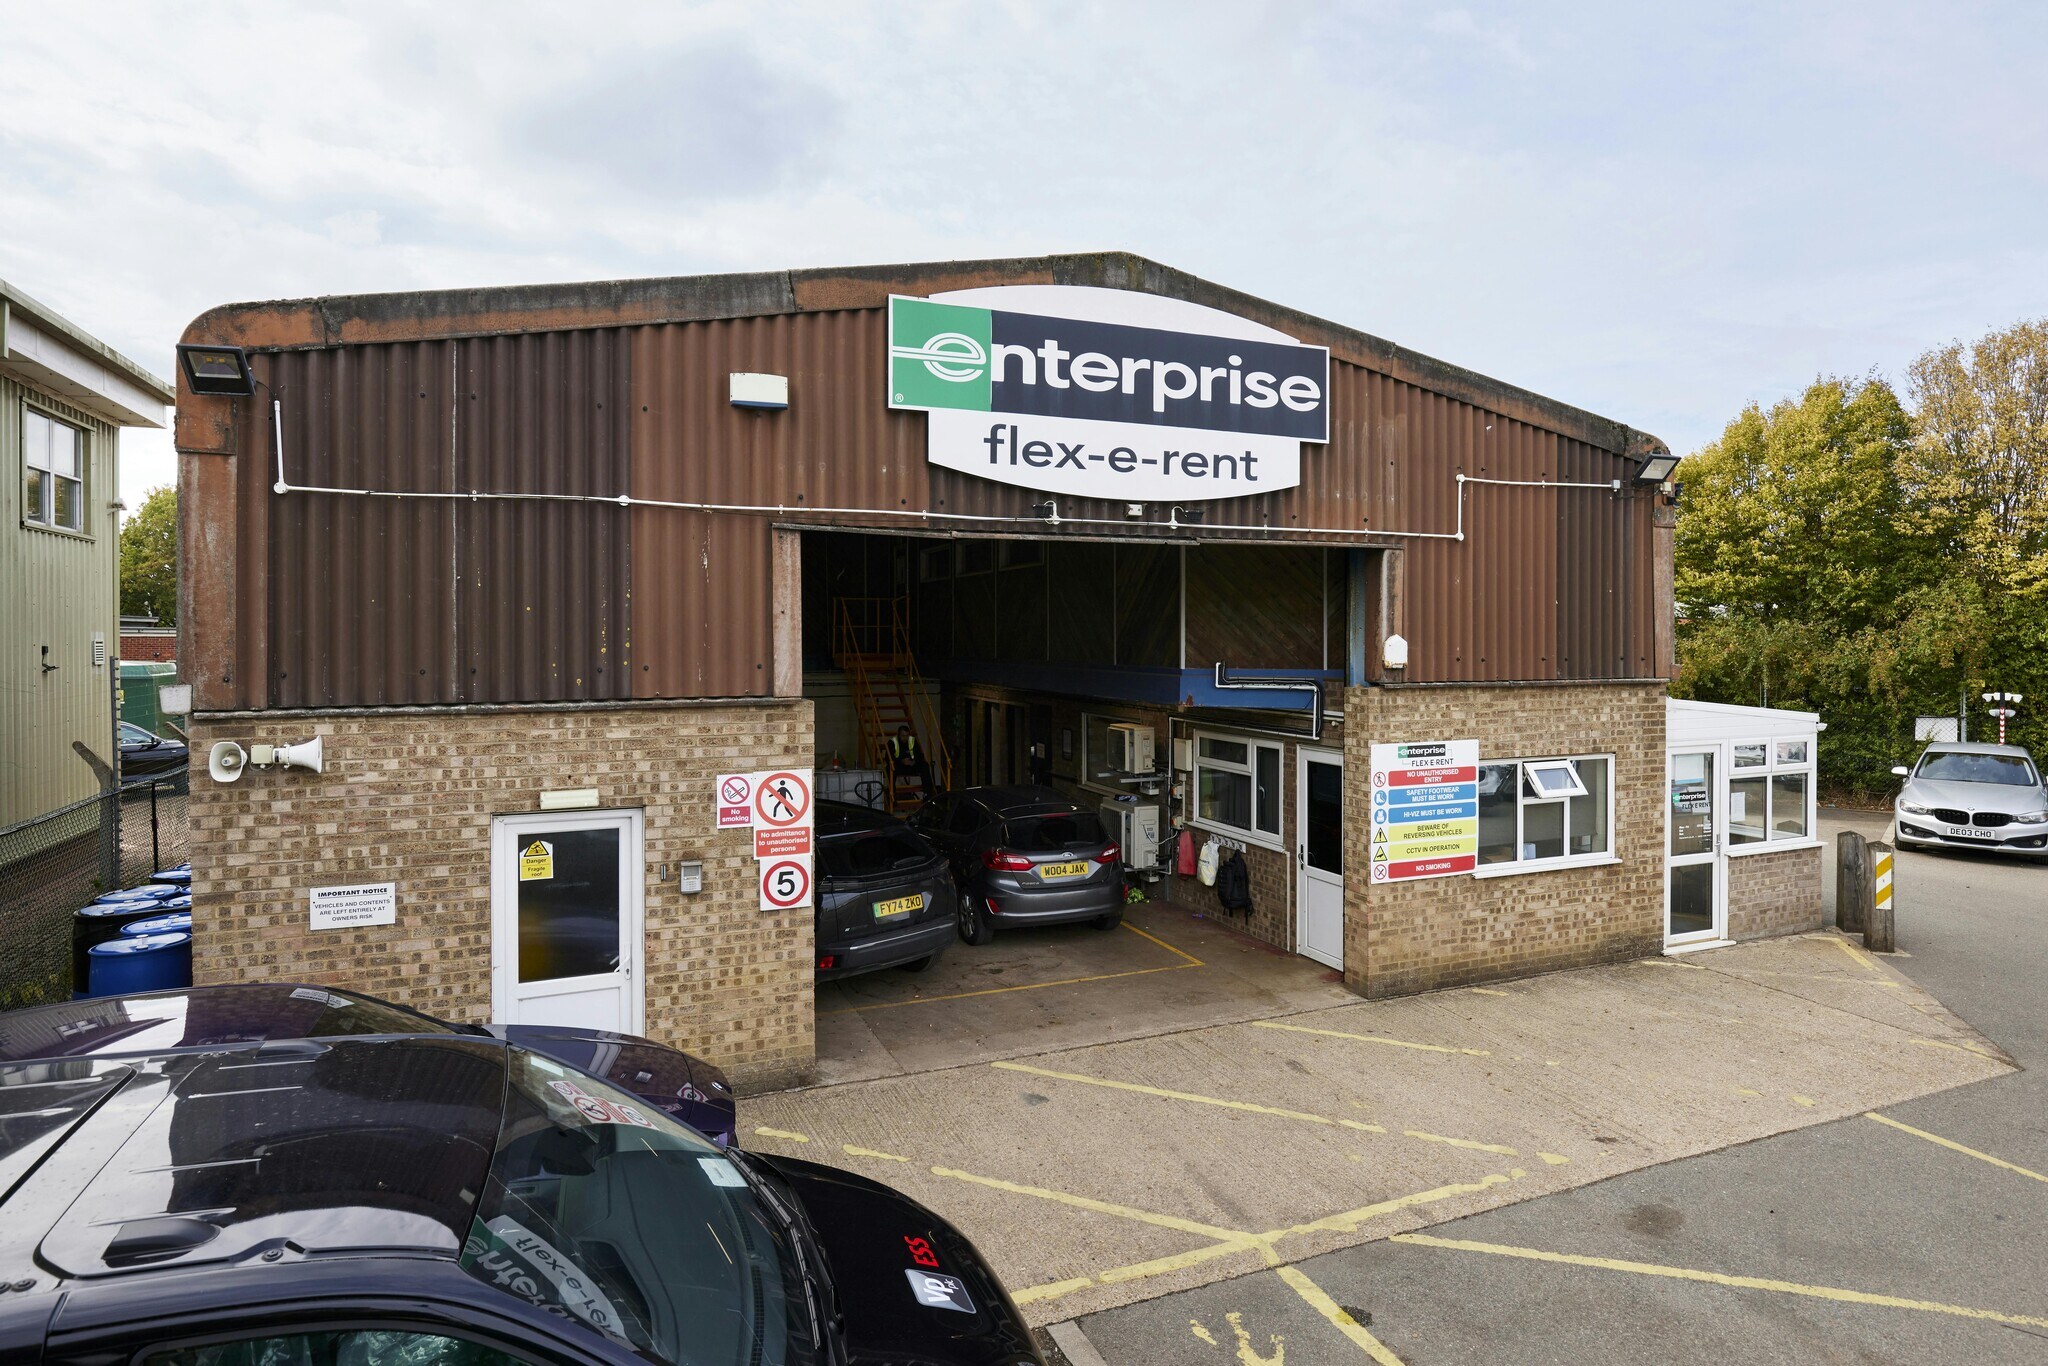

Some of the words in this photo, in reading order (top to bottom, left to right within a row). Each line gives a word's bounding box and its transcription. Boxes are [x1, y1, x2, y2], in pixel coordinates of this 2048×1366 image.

[893, 332, 1321, 413] enterprise
[983, 423, 1258, 481] flex-e-rent
[1399, 746, 1446, 757] enterprise
[1416, 768, 1459, 777] UNAUTHORISED
[1428, 786, 1459, 794] FOOTWEAR
[1445, 807, 1462, 815] WORN
[722, 814, 749, 823] smoking
[771, 830, 806, 838] admittance
[1403, 831, 1434, 839] REVERSING
[1435, 828, 1462, 837] VEHICLES
[1951, 828, 1972, 837] DE03
[1975, 830, 1992, 838] CHO
[766, 837, 807, 845] unauthorised
[770, 845, 796, 854] persons
[1429, 843, 1460, 852] OPERATION
[1070, 864, 1085, 874] JAK
[1425, 862, 1451, 871] SMOKING
[777, 870, 795, 897] 5
[318, 889, 360, 897] IMPORTANT
[362, 887, 388, 895] NOTICE
[880, 901, 903, 914] FY74
[904, 1235, 939, 1267] ESS
